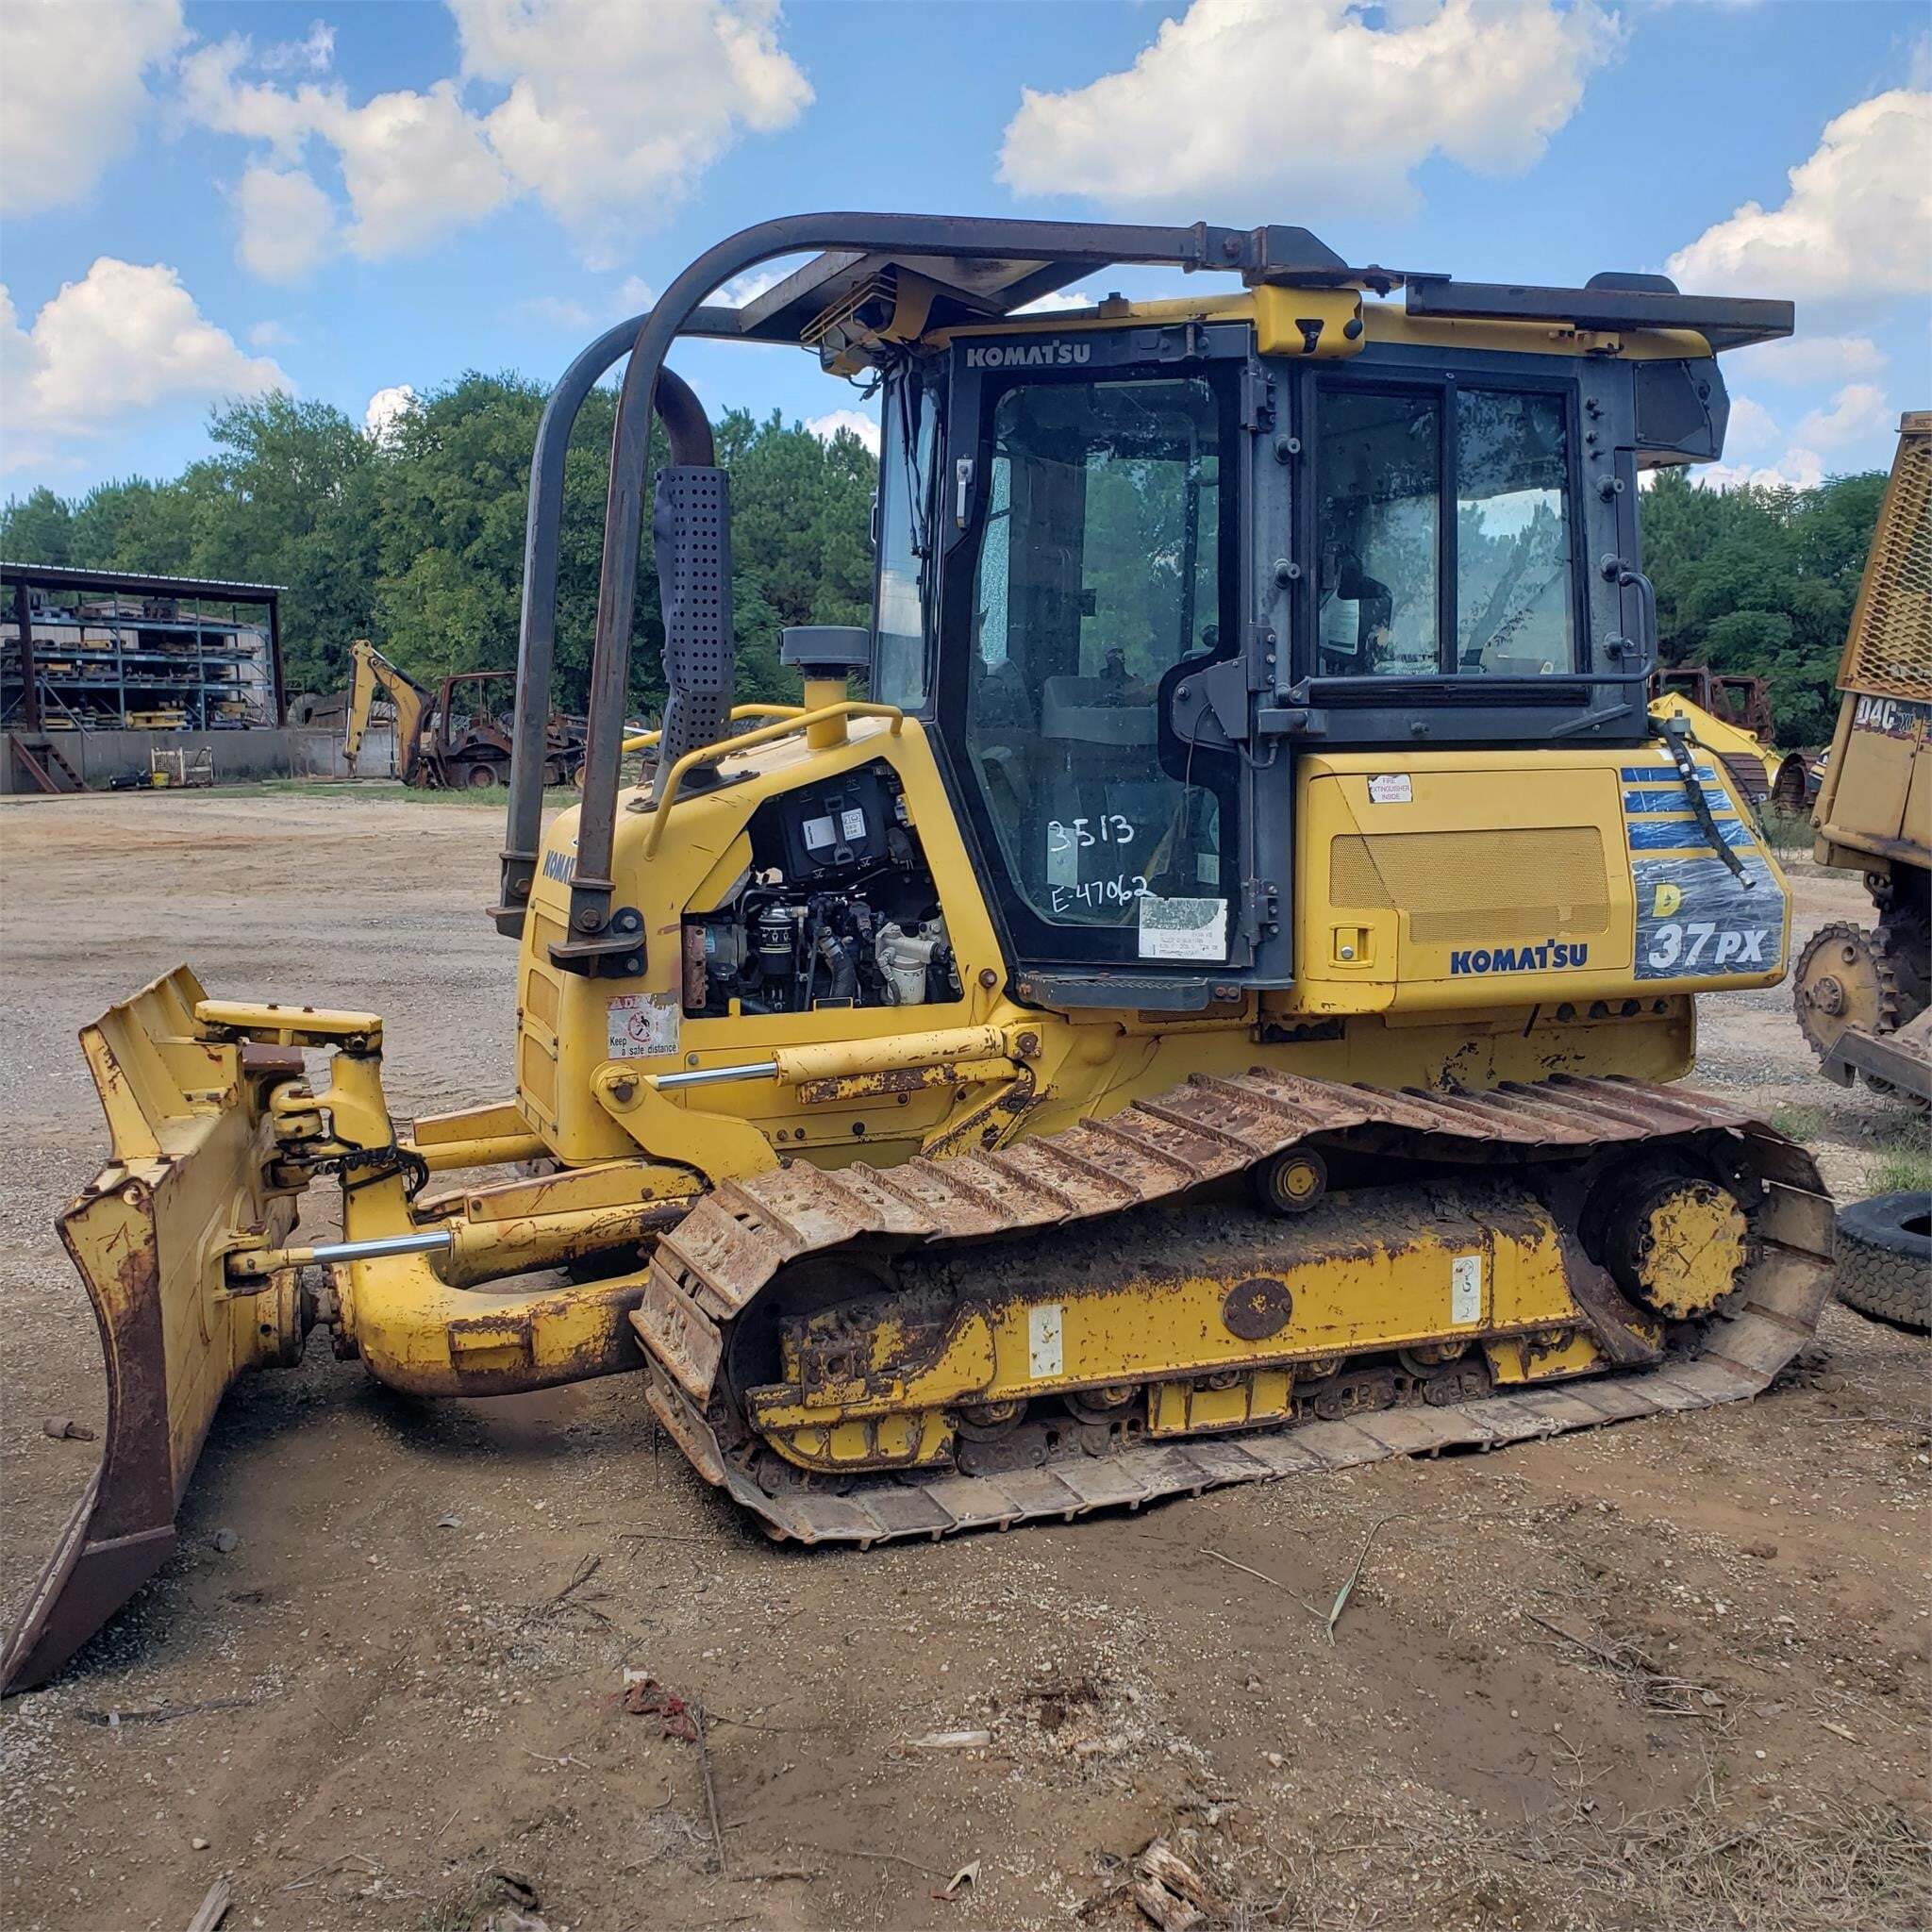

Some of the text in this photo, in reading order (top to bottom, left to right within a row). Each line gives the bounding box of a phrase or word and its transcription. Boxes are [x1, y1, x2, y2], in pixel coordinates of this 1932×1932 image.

[967, 340, 1091, 367] KOMATSU
[1048, 815, 1134, 851] 3513
[1653, 883, 1683, 918] D
[1451, 939, 1588, 974] KOMATSU
[609, 1037, 627, 1046] Keep
[629, 1046, 644, 1055] safe
[647, 1044, 676, 1054] distance
